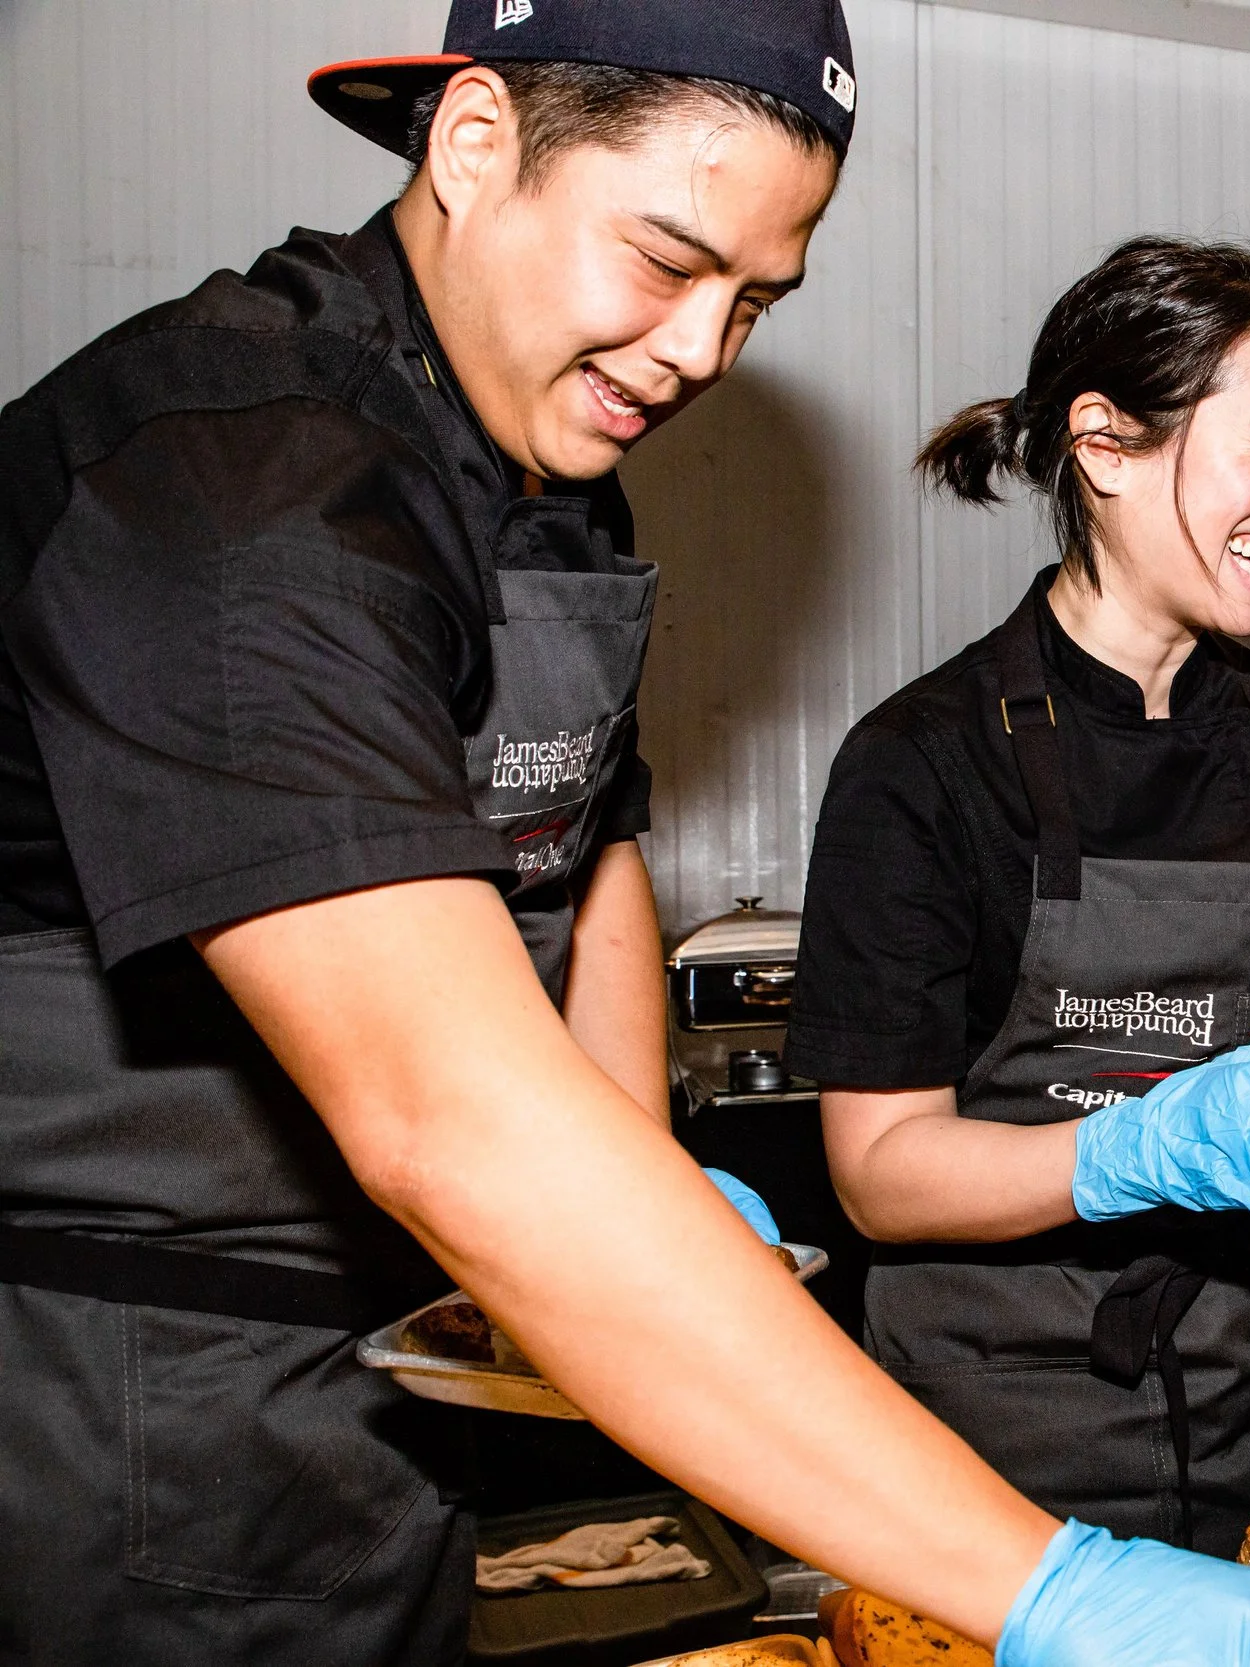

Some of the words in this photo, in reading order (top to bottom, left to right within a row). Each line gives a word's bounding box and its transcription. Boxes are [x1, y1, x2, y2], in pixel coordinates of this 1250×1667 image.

[1055, 988, 1214, 1019] JamesBeard
[1055, 1013, 1213, 1047] Foundation
[1047, 1083, 1127, 1110] Capit
